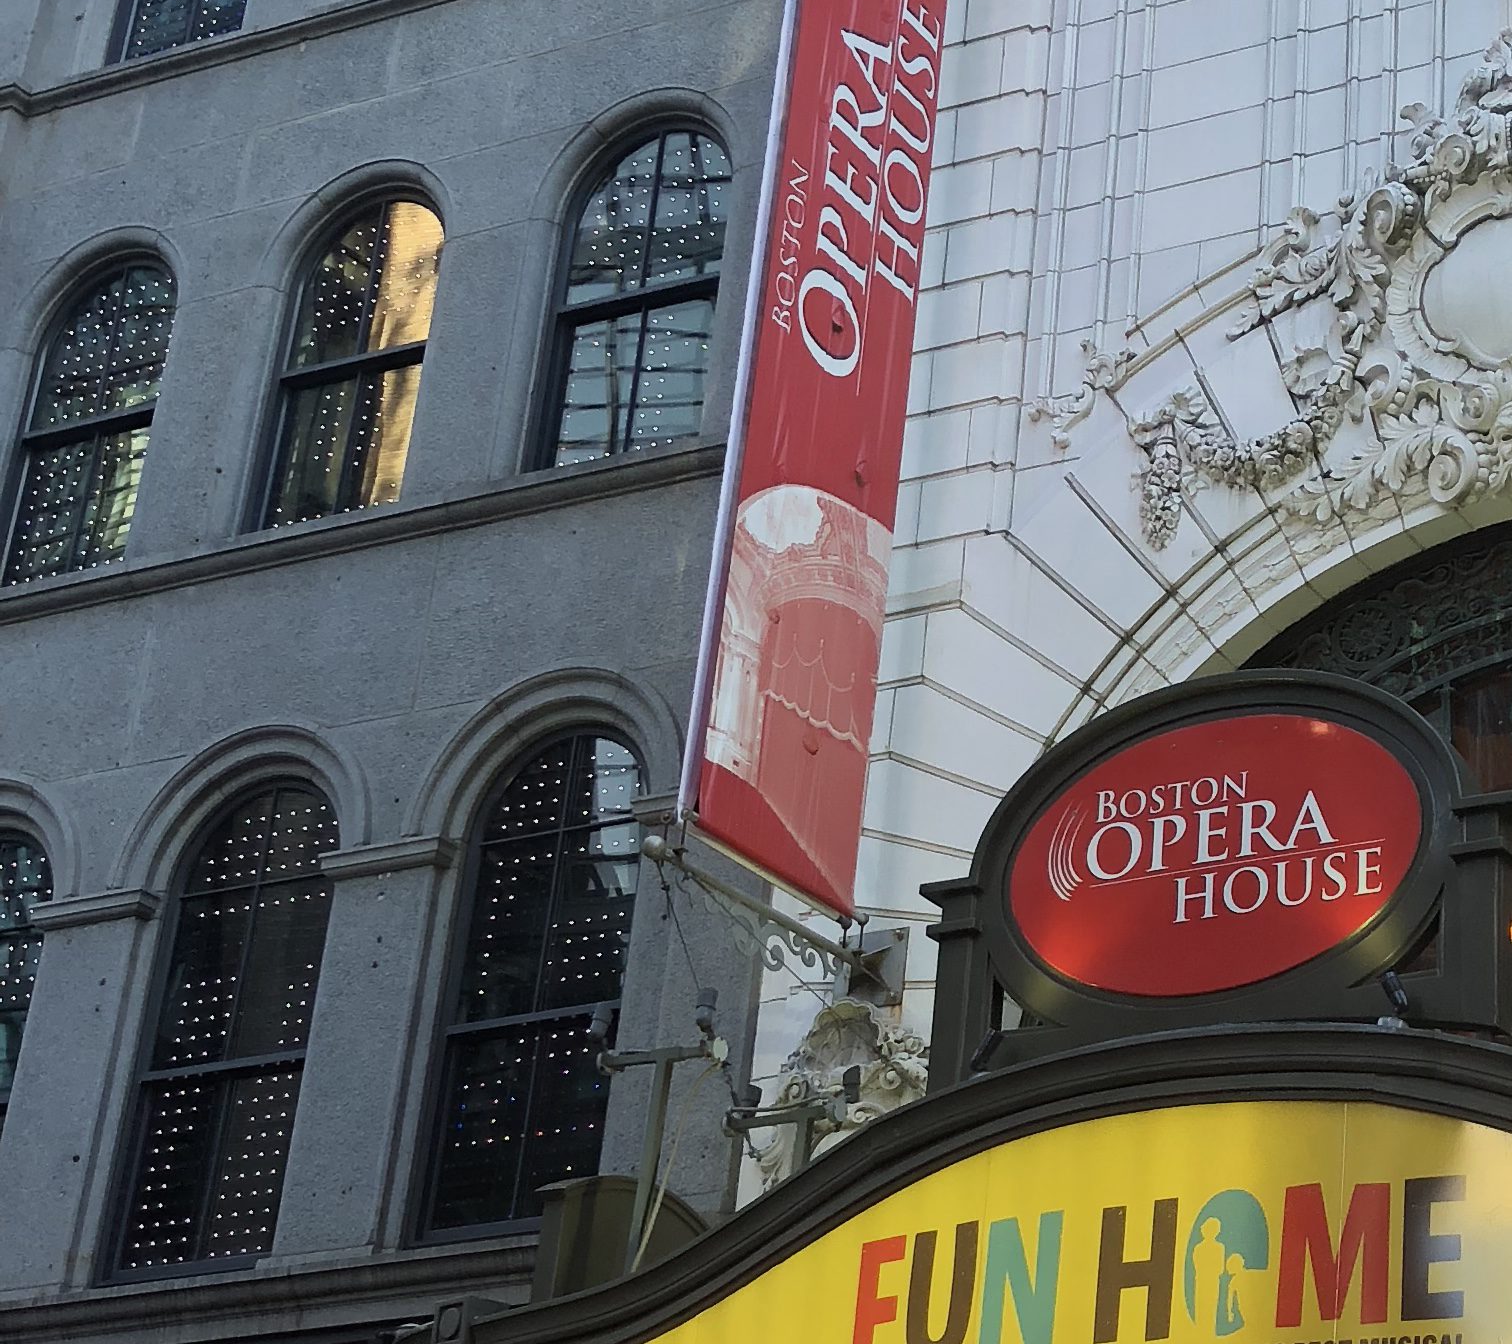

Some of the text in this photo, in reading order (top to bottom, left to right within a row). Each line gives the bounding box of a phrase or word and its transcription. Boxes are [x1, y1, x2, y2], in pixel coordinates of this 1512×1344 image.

[771, 158, 809, 335] BOSTON
[801, 28, 893, 378] OPERA
[1086, 790, 1339, 881] OPERA
[1096, 771, 1249, 823] BOSTON
[1173, 846, 1384, 924] HOUSE
[1093, 1174, 1467, 1344] HOME
